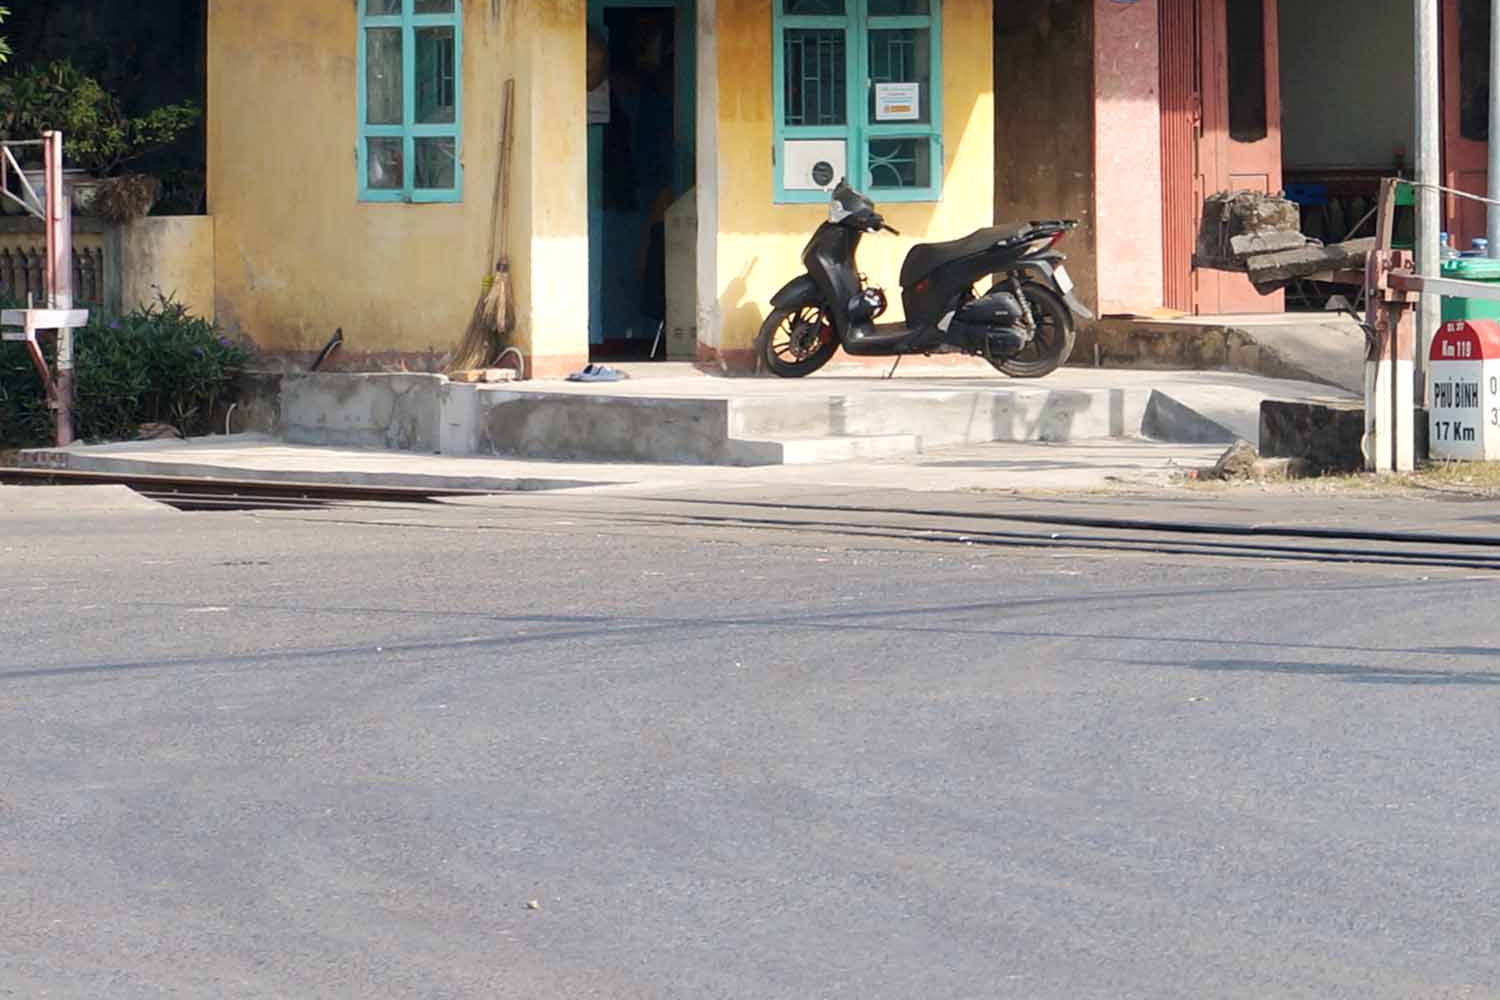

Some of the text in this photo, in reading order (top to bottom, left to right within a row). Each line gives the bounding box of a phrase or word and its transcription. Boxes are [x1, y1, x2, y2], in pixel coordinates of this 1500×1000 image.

[1442, 340, 1472, 357] Km 119
[1455, 376, 1479, 408] BÌNH
[1435, 422, 1475, 440] 17 Km
